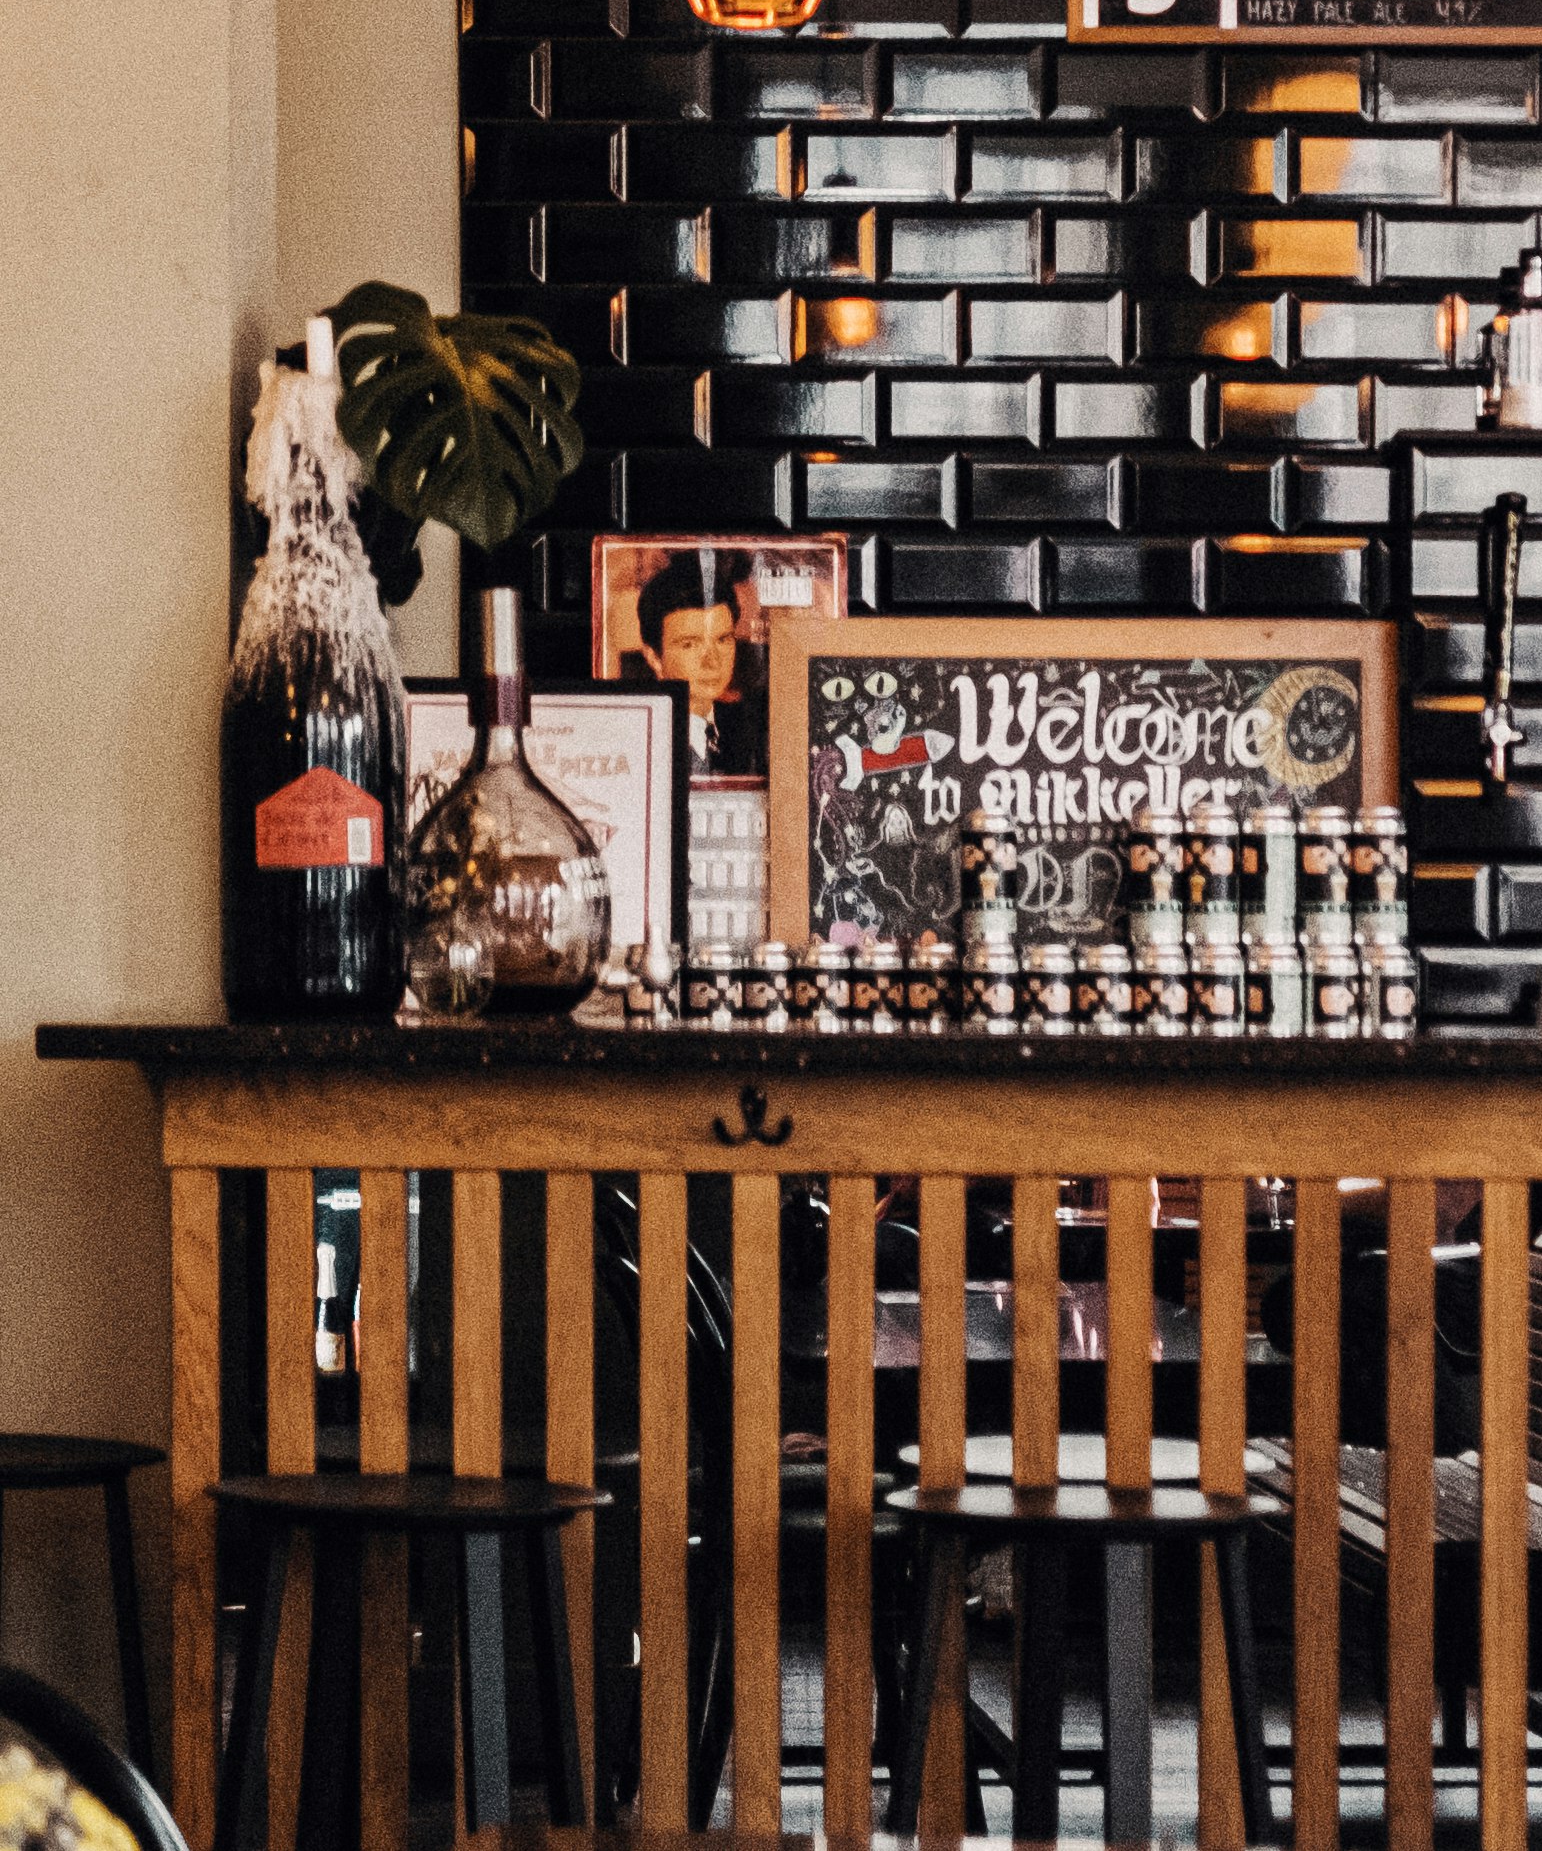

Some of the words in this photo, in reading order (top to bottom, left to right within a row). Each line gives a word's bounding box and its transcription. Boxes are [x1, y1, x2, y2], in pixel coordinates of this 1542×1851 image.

[1247, 1, 1298, 24] HAZY
[1313, 1, 1354, 25] PALE
[950, 670, 1281, 768] Welcome
[917, 765, 961, 826] to
[979, 764, 1243, 828] Mikkeller
